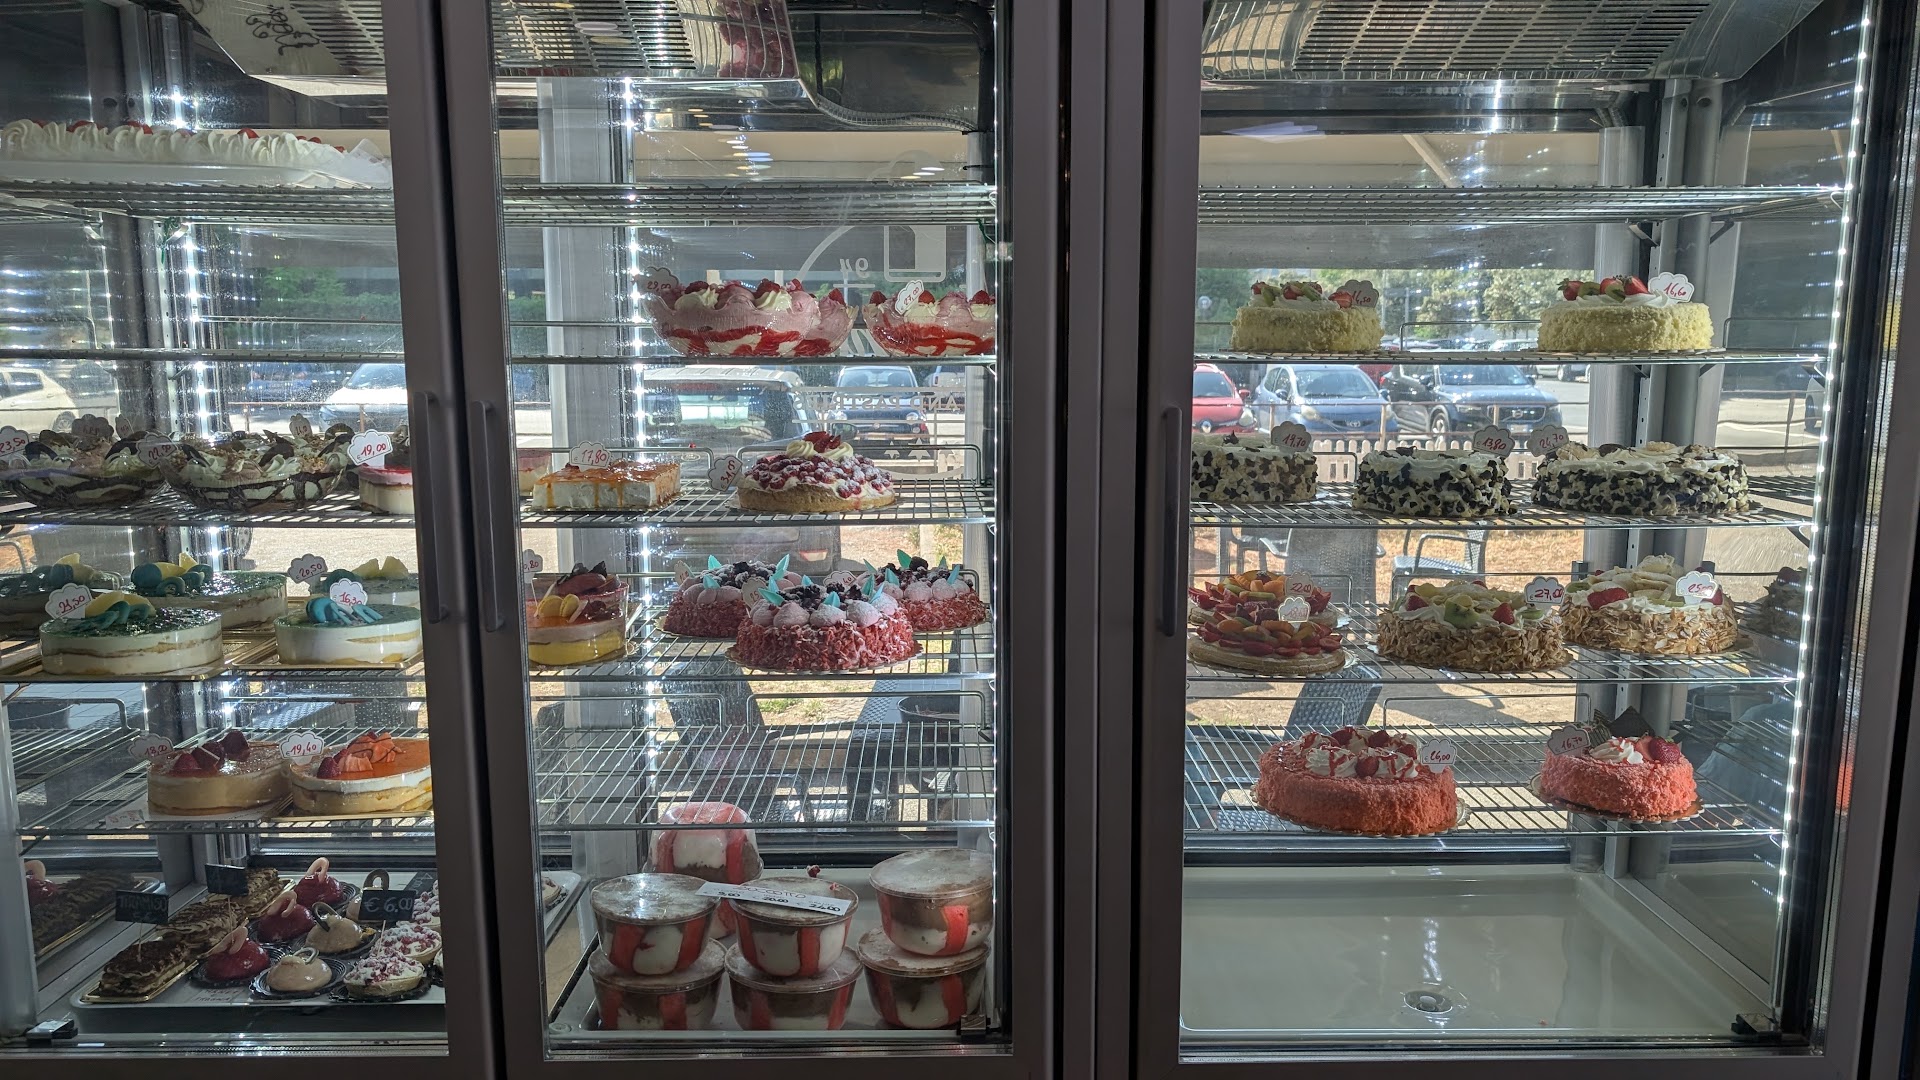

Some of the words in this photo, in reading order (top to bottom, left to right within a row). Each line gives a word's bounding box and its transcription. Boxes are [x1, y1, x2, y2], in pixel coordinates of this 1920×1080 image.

[360, 443, 387, 456] 19,00
[581, 449, 607, 466] 17,80
[299, 563, 323, 578] 20,50
[523, 559, 540, 571] 0,80
[290, 741, 317, 756] 19,40
